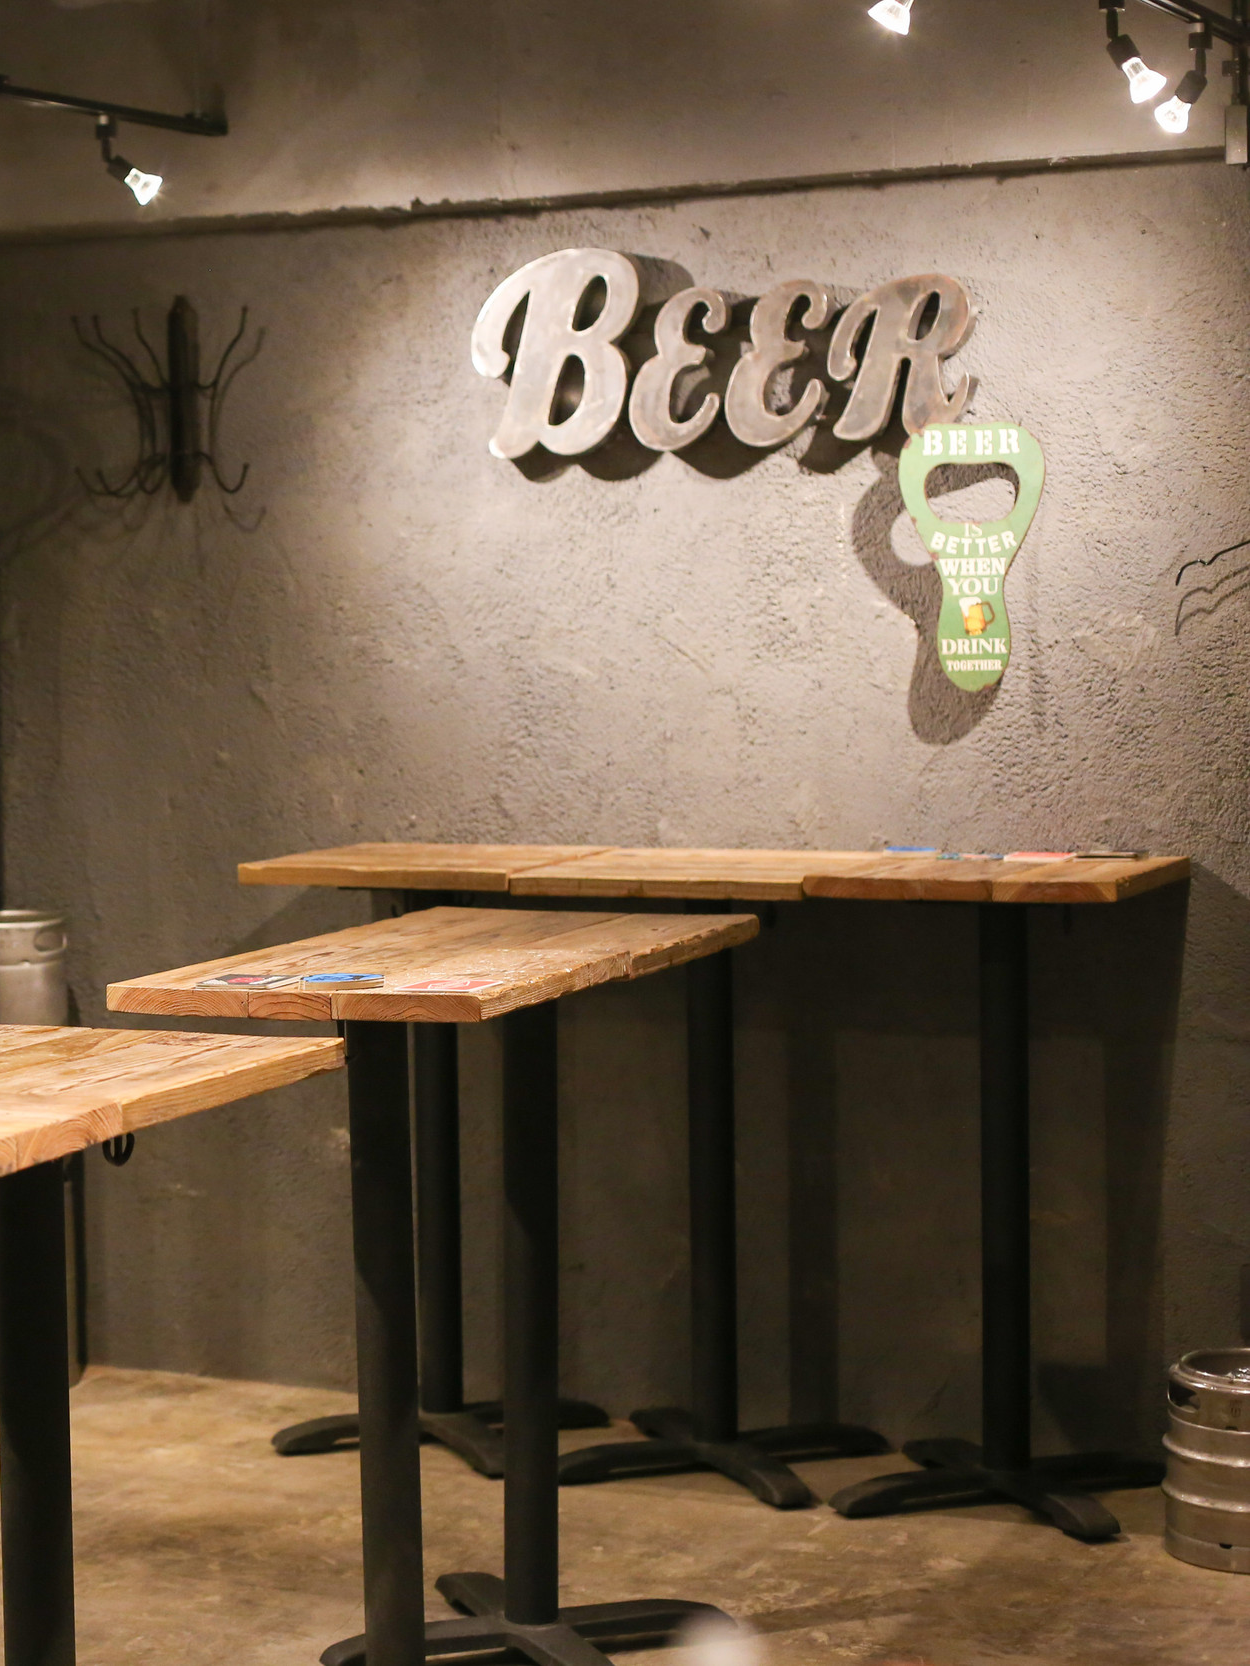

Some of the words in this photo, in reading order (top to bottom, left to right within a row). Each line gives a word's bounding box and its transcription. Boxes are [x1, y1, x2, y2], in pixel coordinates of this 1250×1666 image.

[471, 247, 979, 459] BEER
[922, 428, 1020, 456] BEER
[964, 522, 982, 538] IS
[930, 531, 1017, 556] BETTER
[939, 558, 1007, 576] WHEN
[949, 578, 1000, 595] YOU
[941, 638, 1007, 655] DRINK
[946, 660, 1002, 672] TOGETHER
